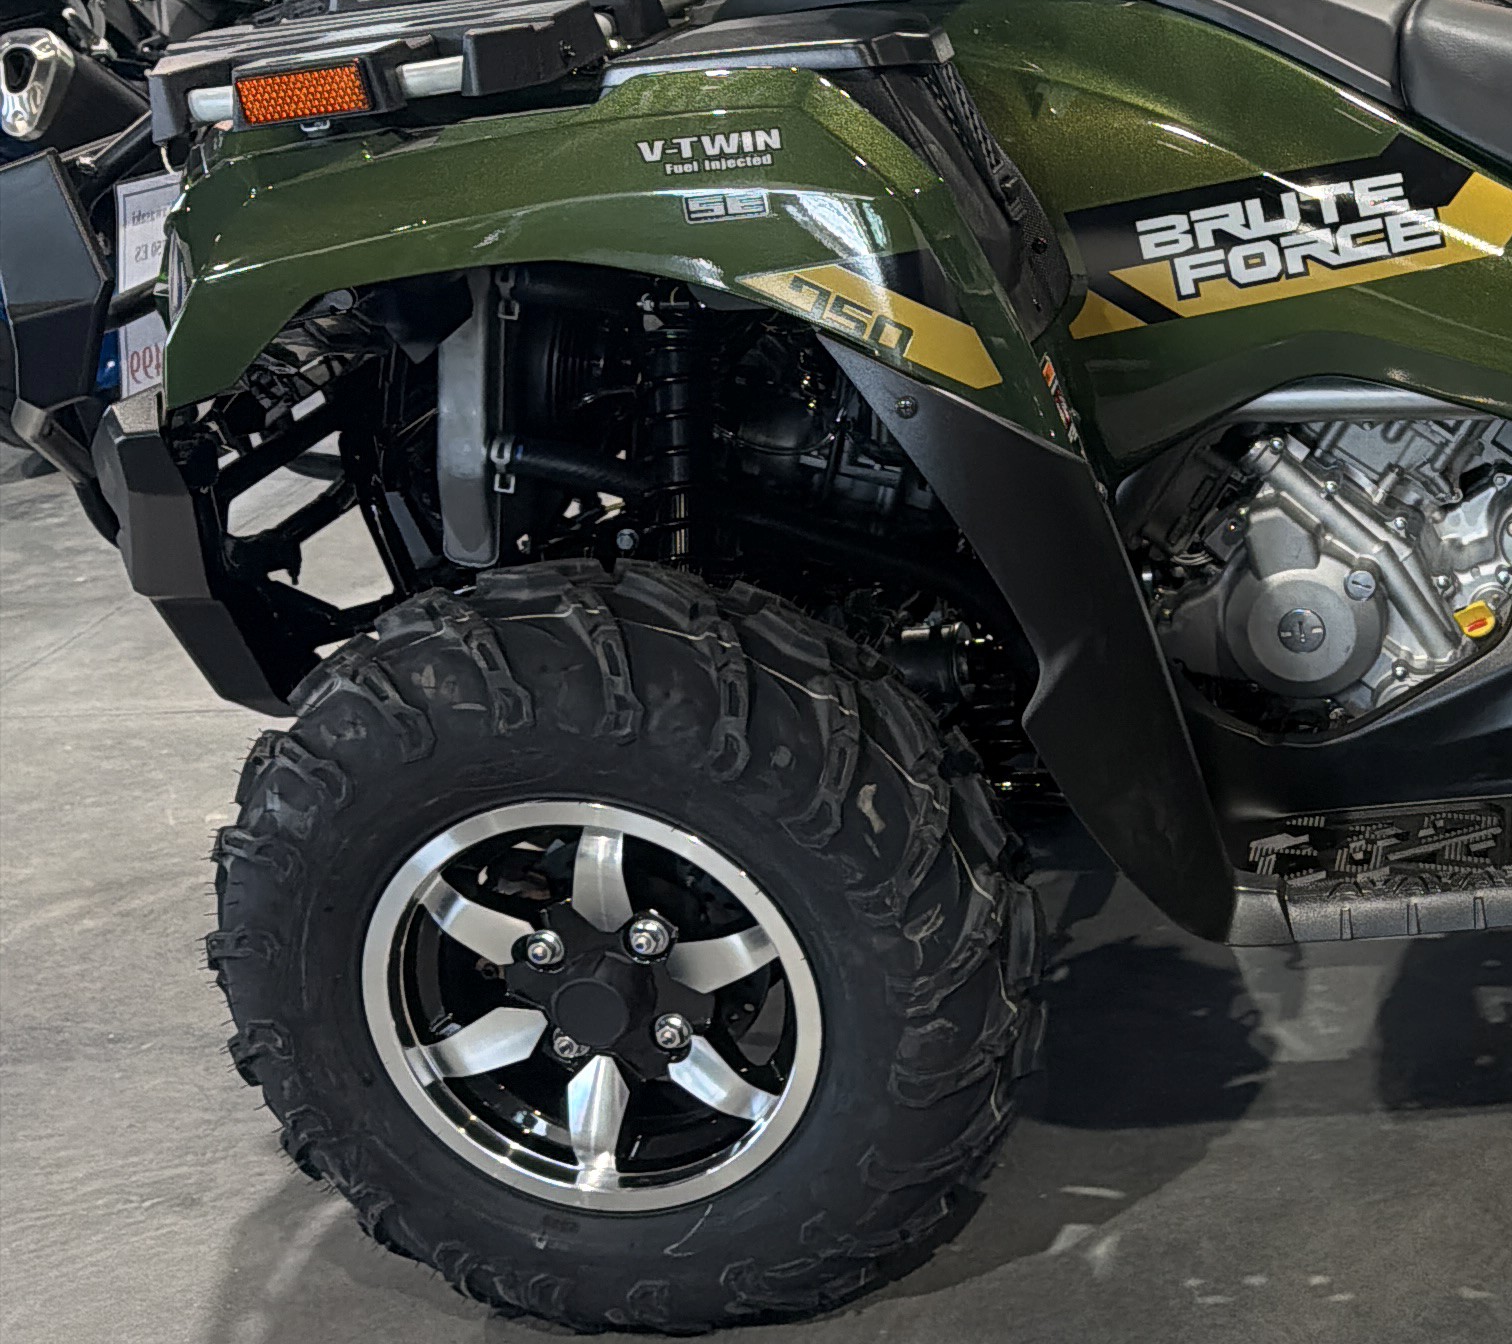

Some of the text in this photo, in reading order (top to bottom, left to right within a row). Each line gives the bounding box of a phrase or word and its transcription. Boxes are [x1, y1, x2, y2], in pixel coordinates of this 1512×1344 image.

[636, 127, 783, 163] V-TWIN
[664, 153, 773, 176] Fuel Injected
[685, 194, 767, 219] SE
[1134, 172, 1411, 260] BRUTE
[1171, 207, 1444, 297] FORCE
[790, 273, 915, 359] 750
